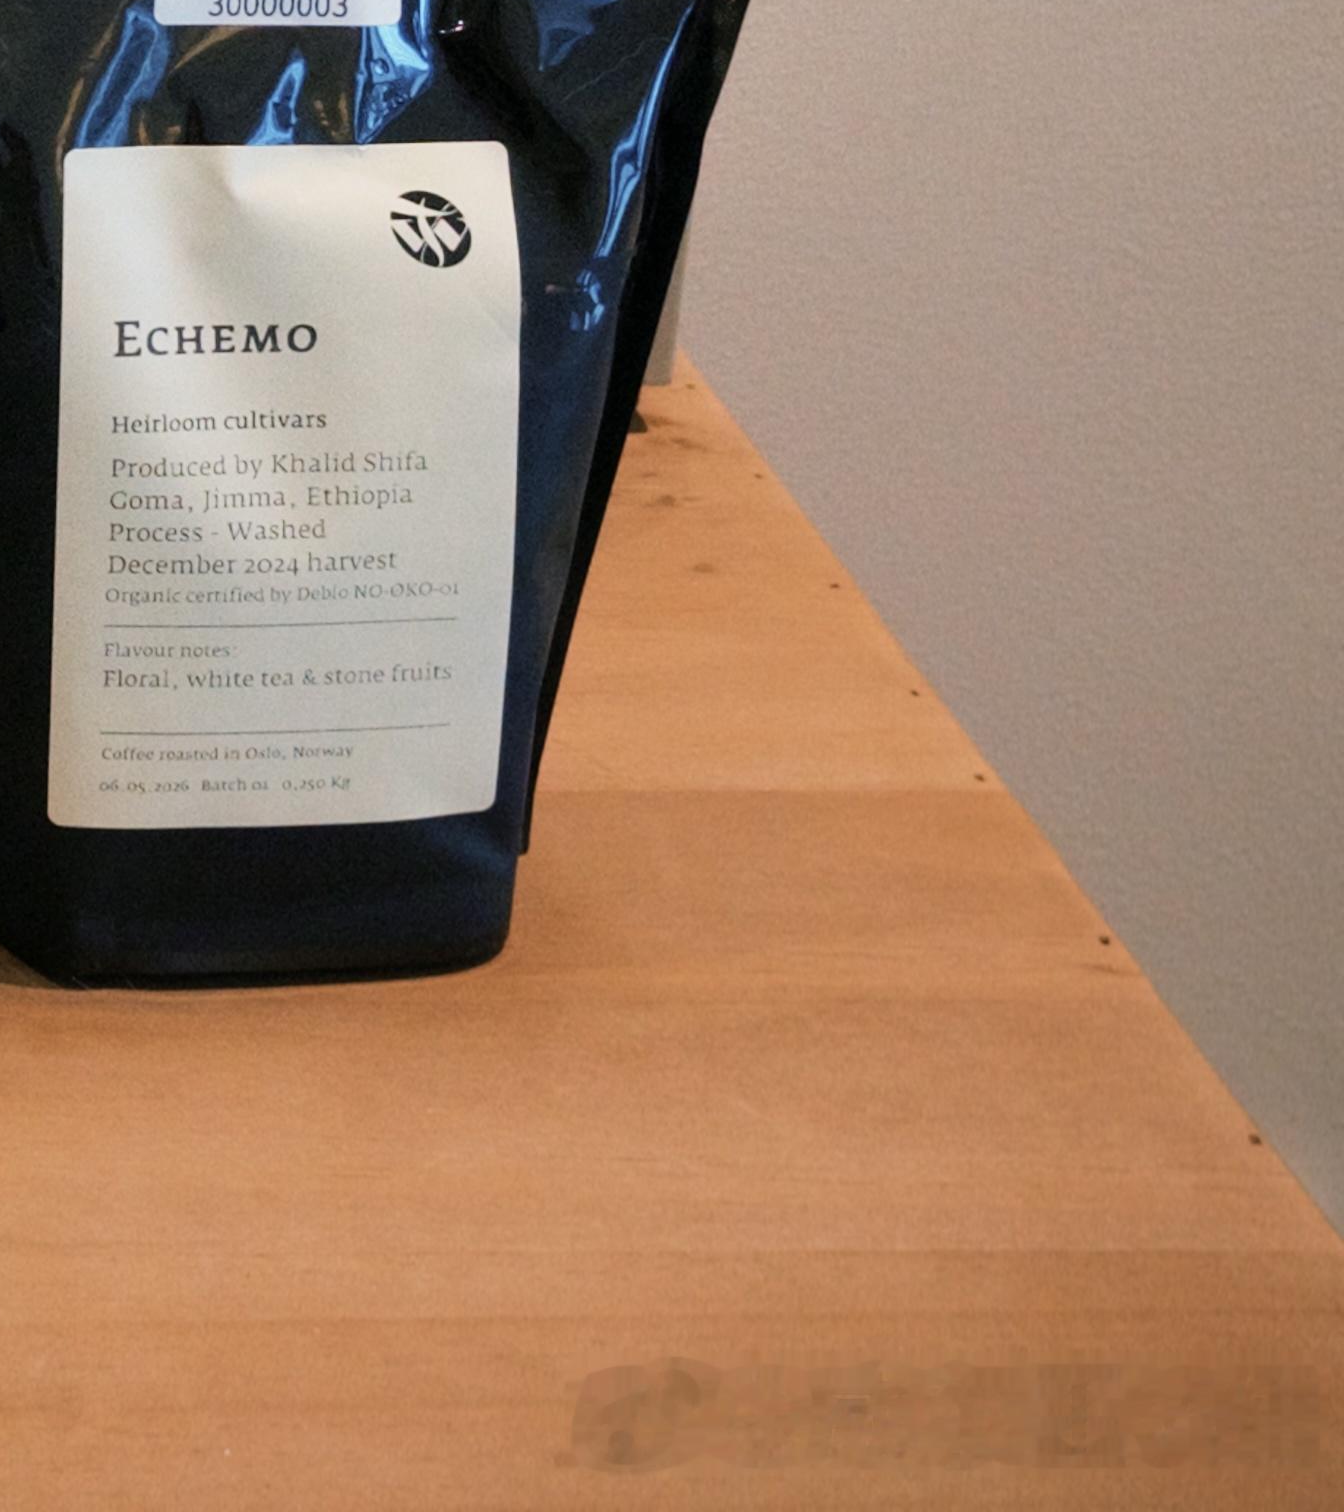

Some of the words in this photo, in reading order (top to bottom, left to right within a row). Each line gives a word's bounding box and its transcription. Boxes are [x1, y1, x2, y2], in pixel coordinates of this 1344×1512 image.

[112, 414, 216, 434] Heirloom
[223, 410, 328, 430] cultivars
[112, 455, 227, 478] Produced
[234, 454, 262, 480] by
[272, 452, 356, 474] Khalid
[363, 449, 429, 472] Shifa
[109, 490, 194, 513] Goma,
[202, 488, 298, 513] Jimma,
[306, 484, 414, 509] Ethiopia
[110, 522, 203, 543] Process
[227, 518, 327, 541] Washed
[108, 554, 237, 575] December
[243, 557, 300, 576] 2024
[308, 551, 397, 572] harvest
[105, 587, 181, 606] Organic
[185, 584, 265, 603] certified
[269, 585, 292, 604] by
[296, 583, 349, 602] Debio
[103, 642, 173, 658] Flavour
[102, 668, 179, 690] Floral,
[187, 667, 255, 688] white
[261, 669, 295, 687] tea
[301, 668, 317, 687] &
[323, 667, 387, 685] stone
[391, 662, 453, 683] fruits
[101, 747, 154, 761] Coffee
[159, 746, 219, 761] roasted
[223, 746, 241, 761] in
[292, 744, 355, 759] Norway
[201, 777, 247, 792] Batch
